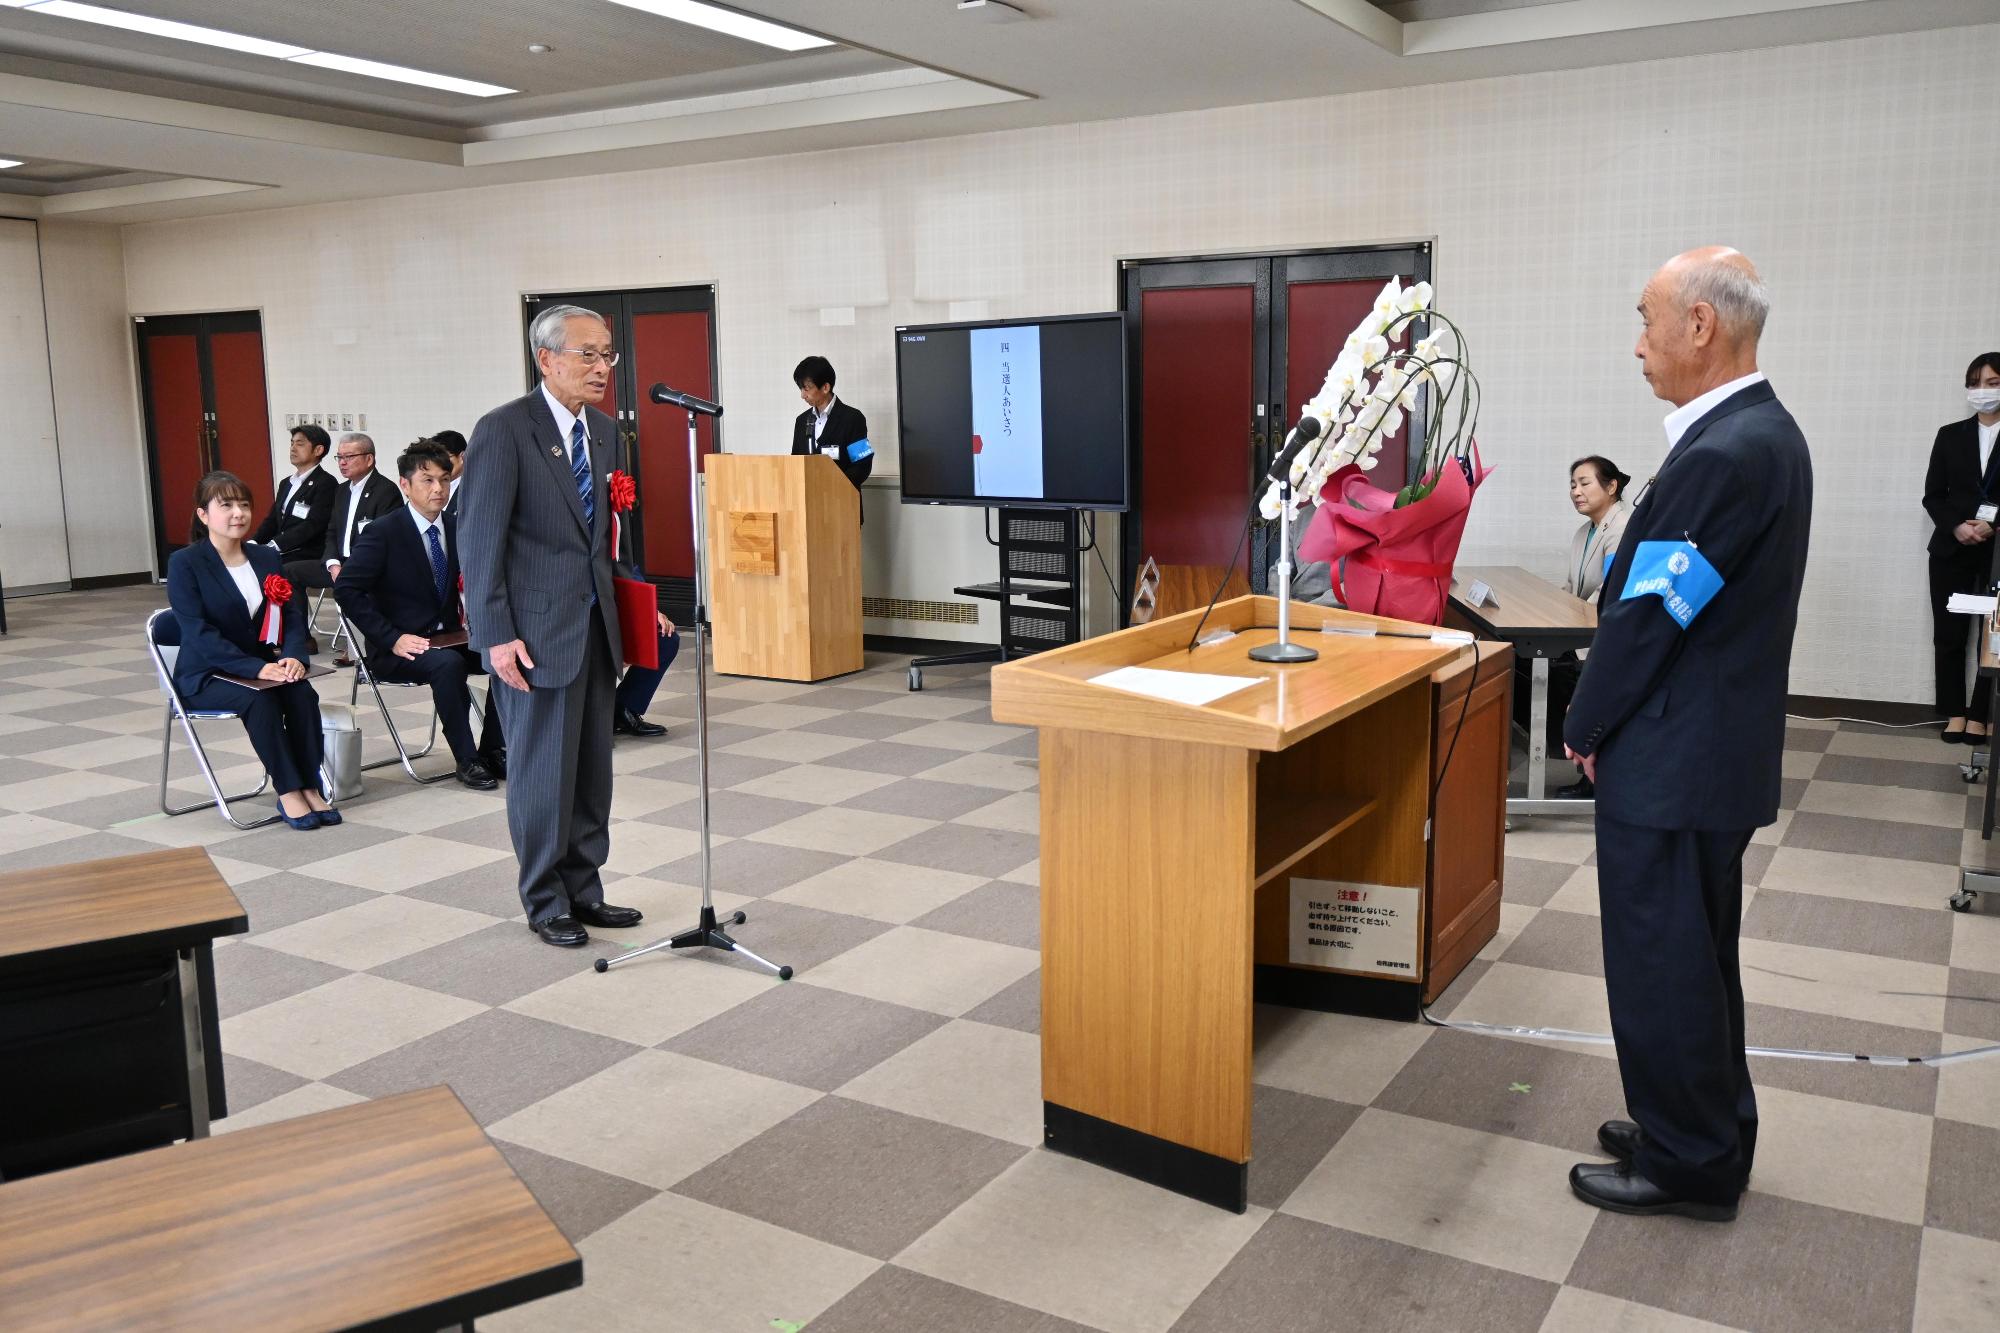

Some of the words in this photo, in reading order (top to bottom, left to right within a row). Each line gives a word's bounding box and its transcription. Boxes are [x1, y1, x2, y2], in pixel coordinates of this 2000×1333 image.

[1000, 342, 1010, 353] 四
[1002, 361, 1012, 436] 当選人あいさつ
[1337, 889, 1367, 901] 注意！
